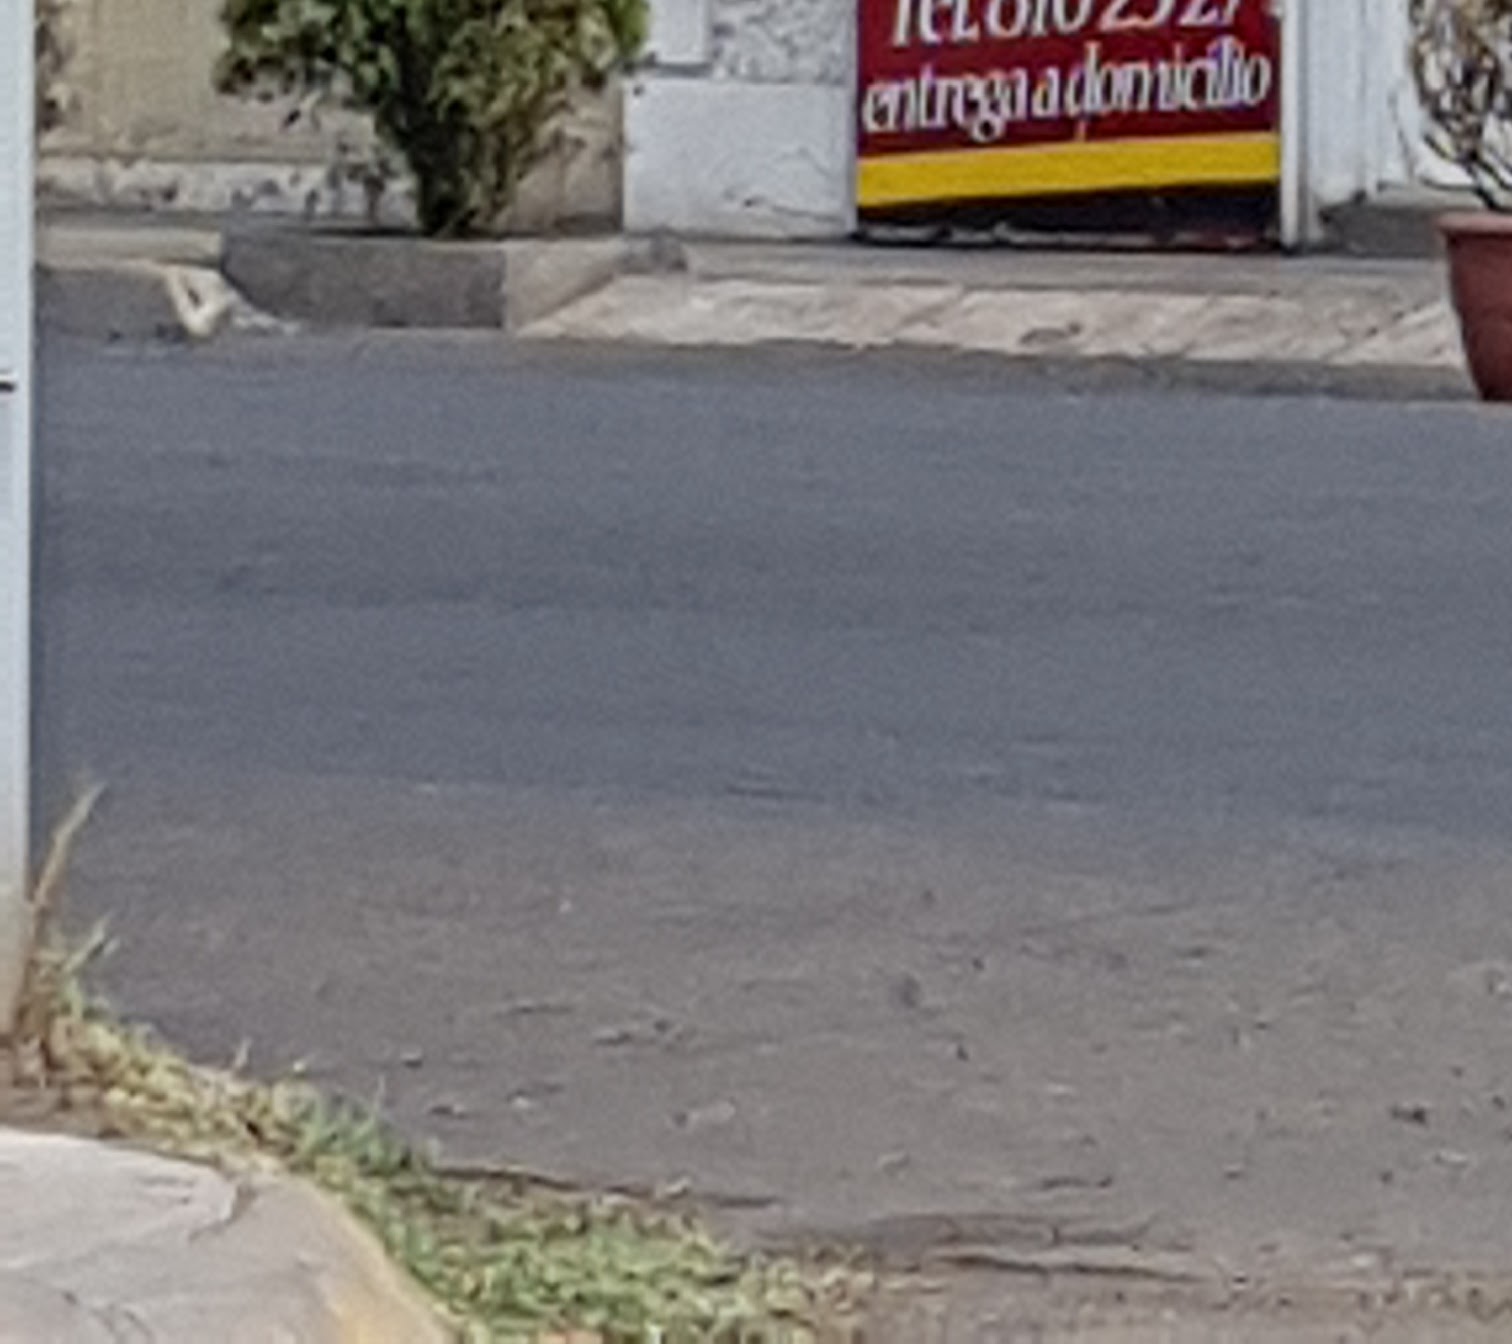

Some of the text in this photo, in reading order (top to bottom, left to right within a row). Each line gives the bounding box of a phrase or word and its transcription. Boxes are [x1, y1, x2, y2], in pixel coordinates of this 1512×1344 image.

[862, 34, 1274, 144] entrega a domicilio
